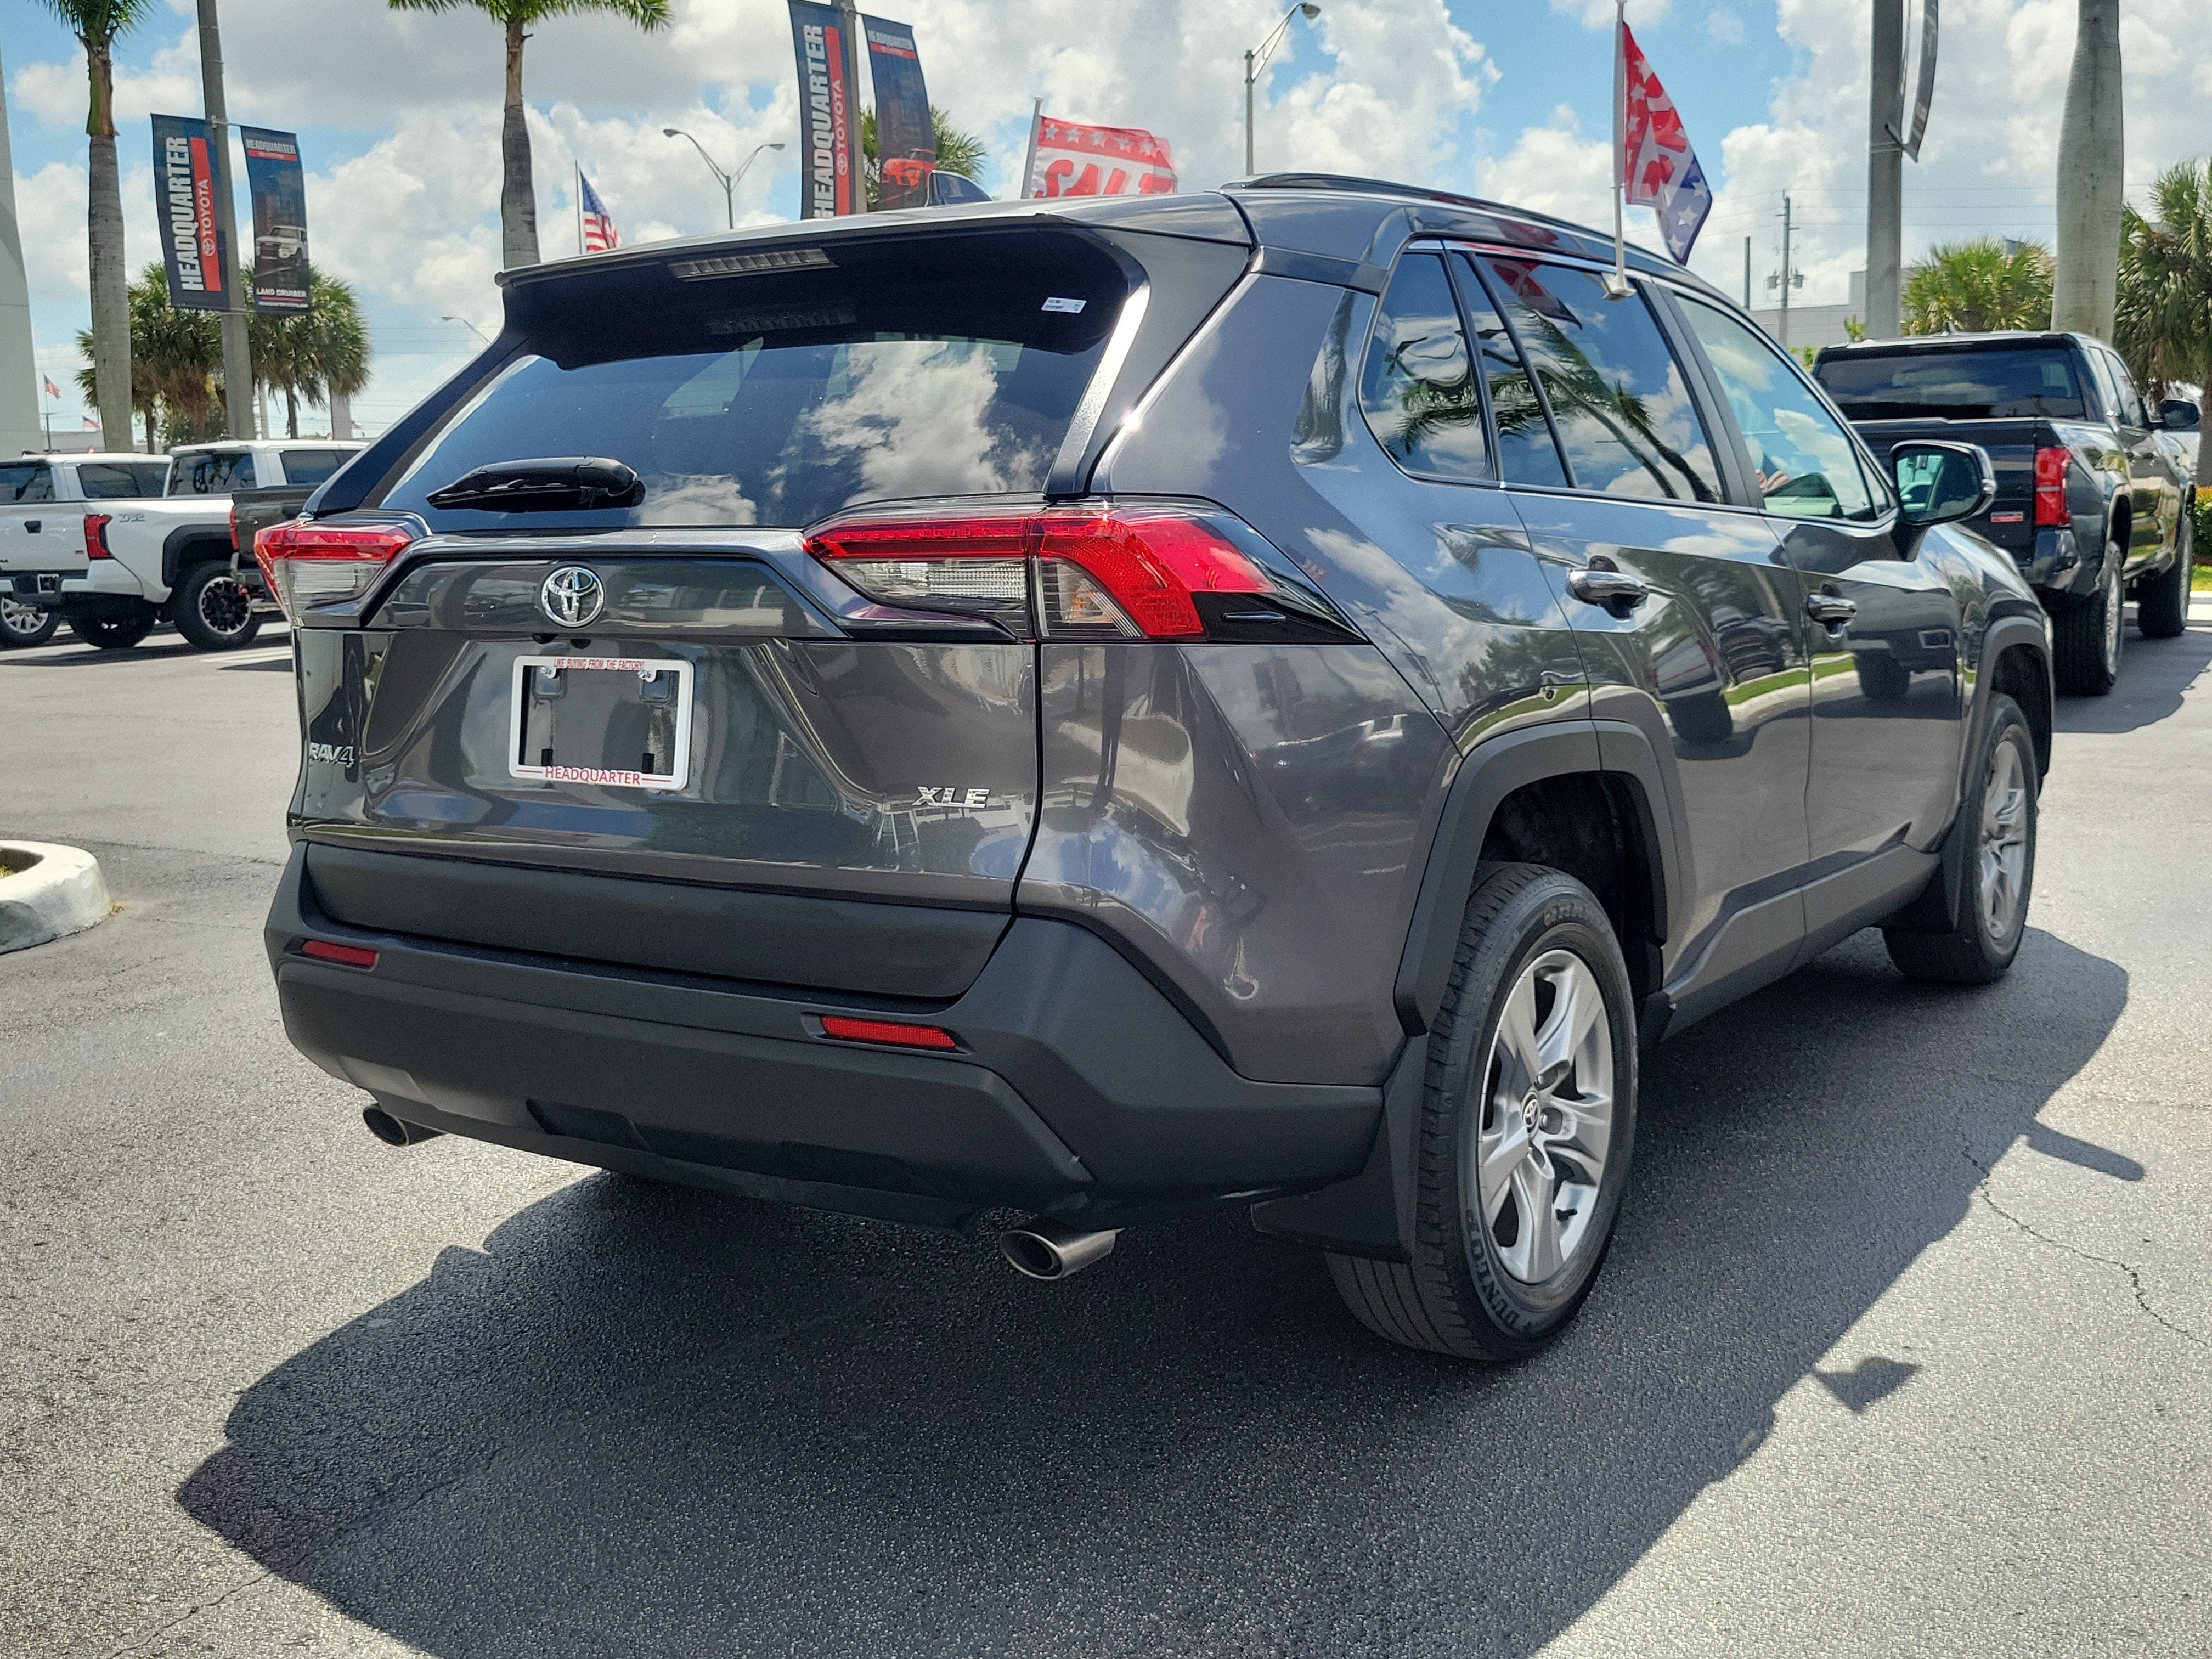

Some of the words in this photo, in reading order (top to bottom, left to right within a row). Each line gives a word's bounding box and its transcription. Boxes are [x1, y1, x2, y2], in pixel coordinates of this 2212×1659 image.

[804, 25, 834, 218] HEADQUARTER
[832, 80, 847, 150] TOYOTA
[166, 137, 204, 291] HEADQUARTER
[198, 179, 213, 236] TOYOTA
[555, 658, 565, 667] LIKE
[567, 659, 586, 669] BUYING
[589, 659, 603, 669] FROM
[607, 660, 617, 669] THE
[309, 742, 356, 768] RAV4
[545, 766, 640, 785] HEADQUARTER
[911, 786, 990, 809] XLE
